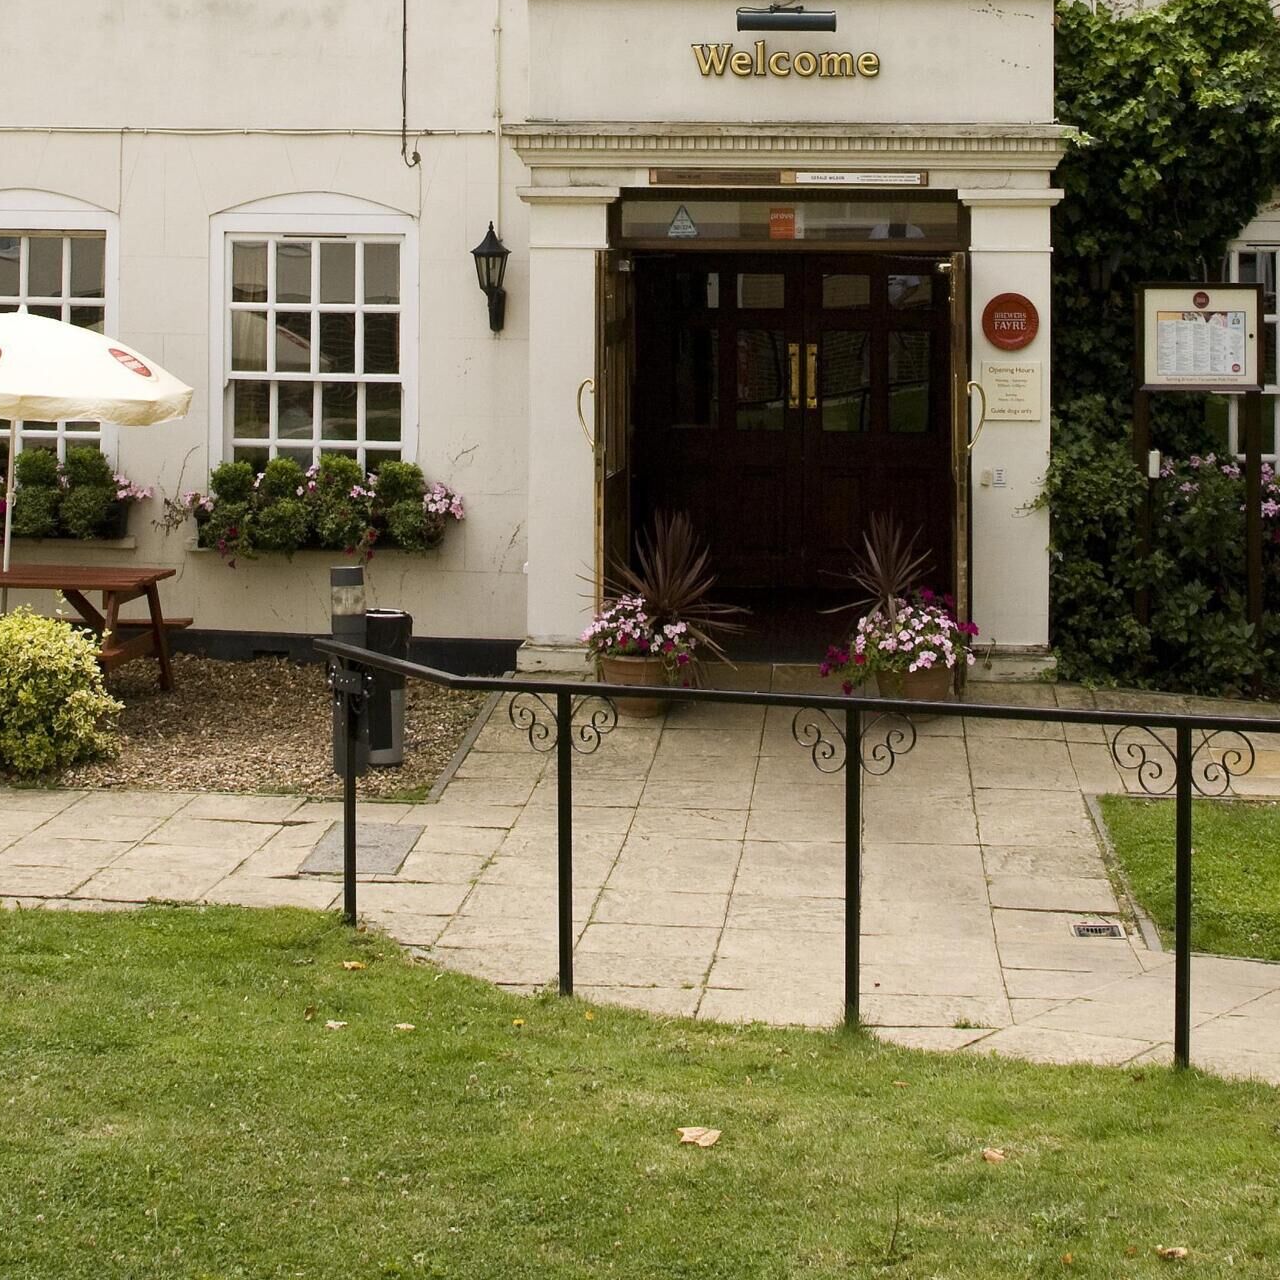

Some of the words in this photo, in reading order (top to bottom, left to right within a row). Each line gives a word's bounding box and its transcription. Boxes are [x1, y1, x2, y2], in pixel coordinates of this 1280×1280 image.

[691, 40, 881, 77] Welcome
[994, 321, 1027, 330] FAYRE
[988, 366, 1014, 374] Opening
